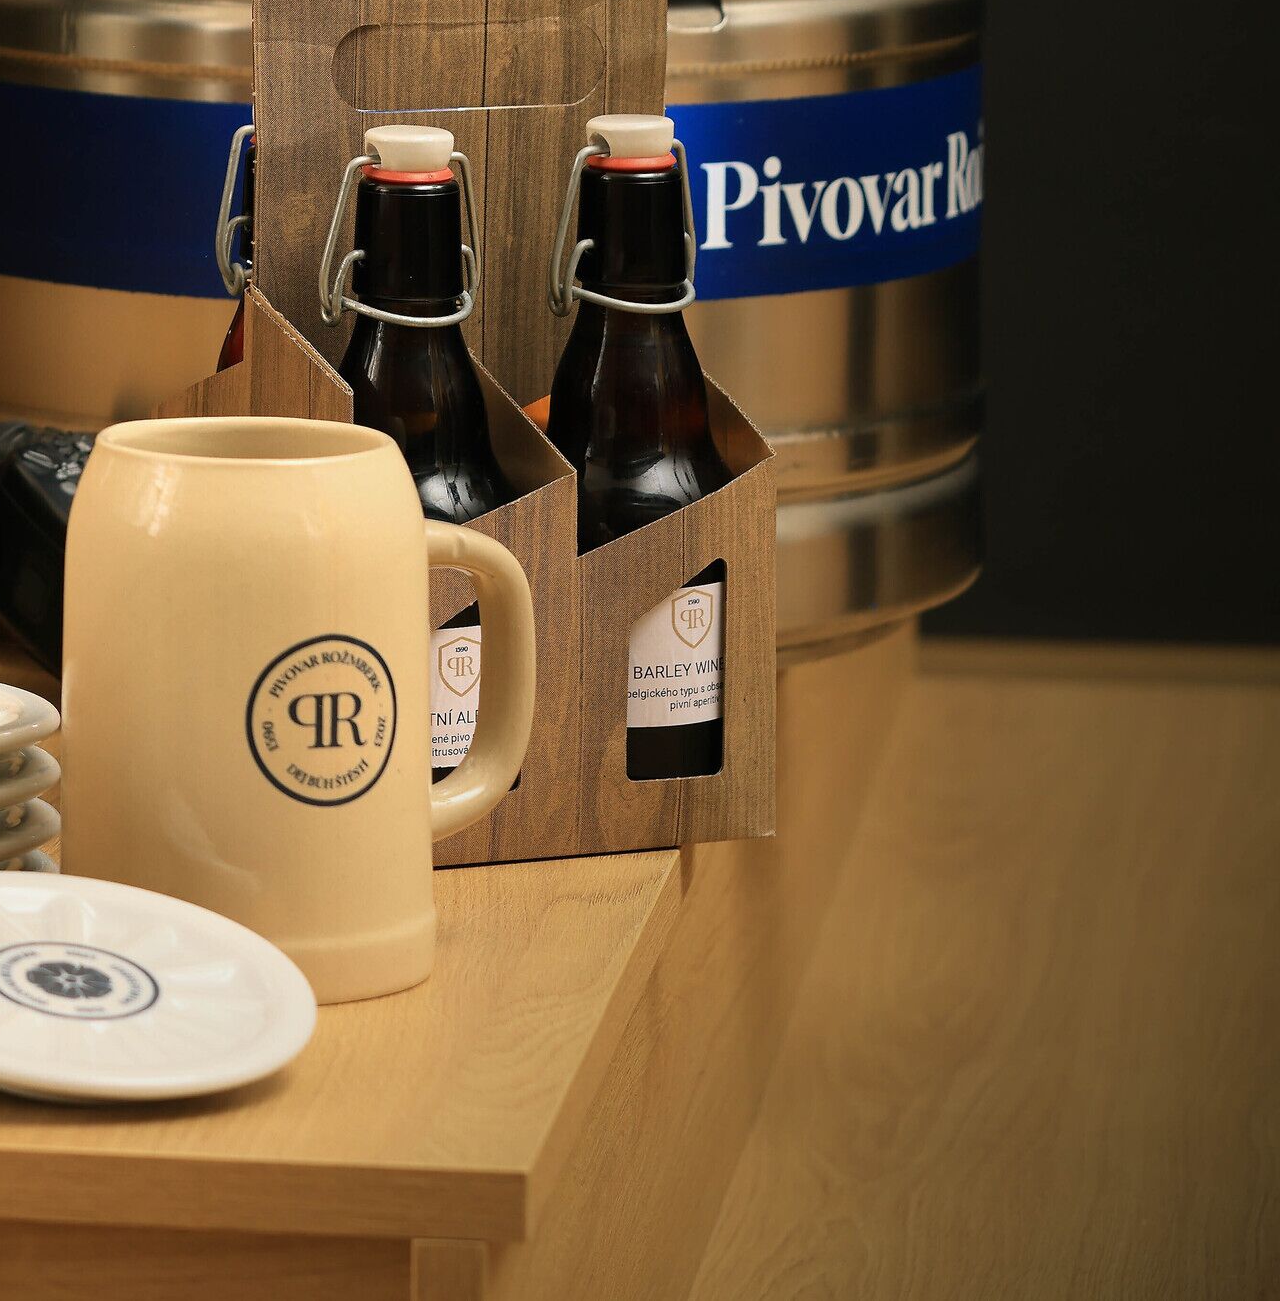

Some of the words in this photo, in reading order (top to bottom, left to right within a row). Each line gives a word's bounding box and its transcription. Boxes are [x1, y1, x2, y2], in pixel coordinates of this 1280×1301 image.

[699, 155, 944, 250] Pivovar
[269, 654, 321, 699] PIVOVAR
[321, 650, 382, 694] ROŽMBERK
[633, 663, 692, 680] BARLEY
[680, 686, 699, 698] typu
[700, 684, 705, 693] s
[669, 701, 691, 712] pivní
[430, 708, 453, 726] TNÍ
[431, 734, 449, 744] ené
[451, 733, 470, 746] pivo
[431, 746, 469, 757] itrusová
